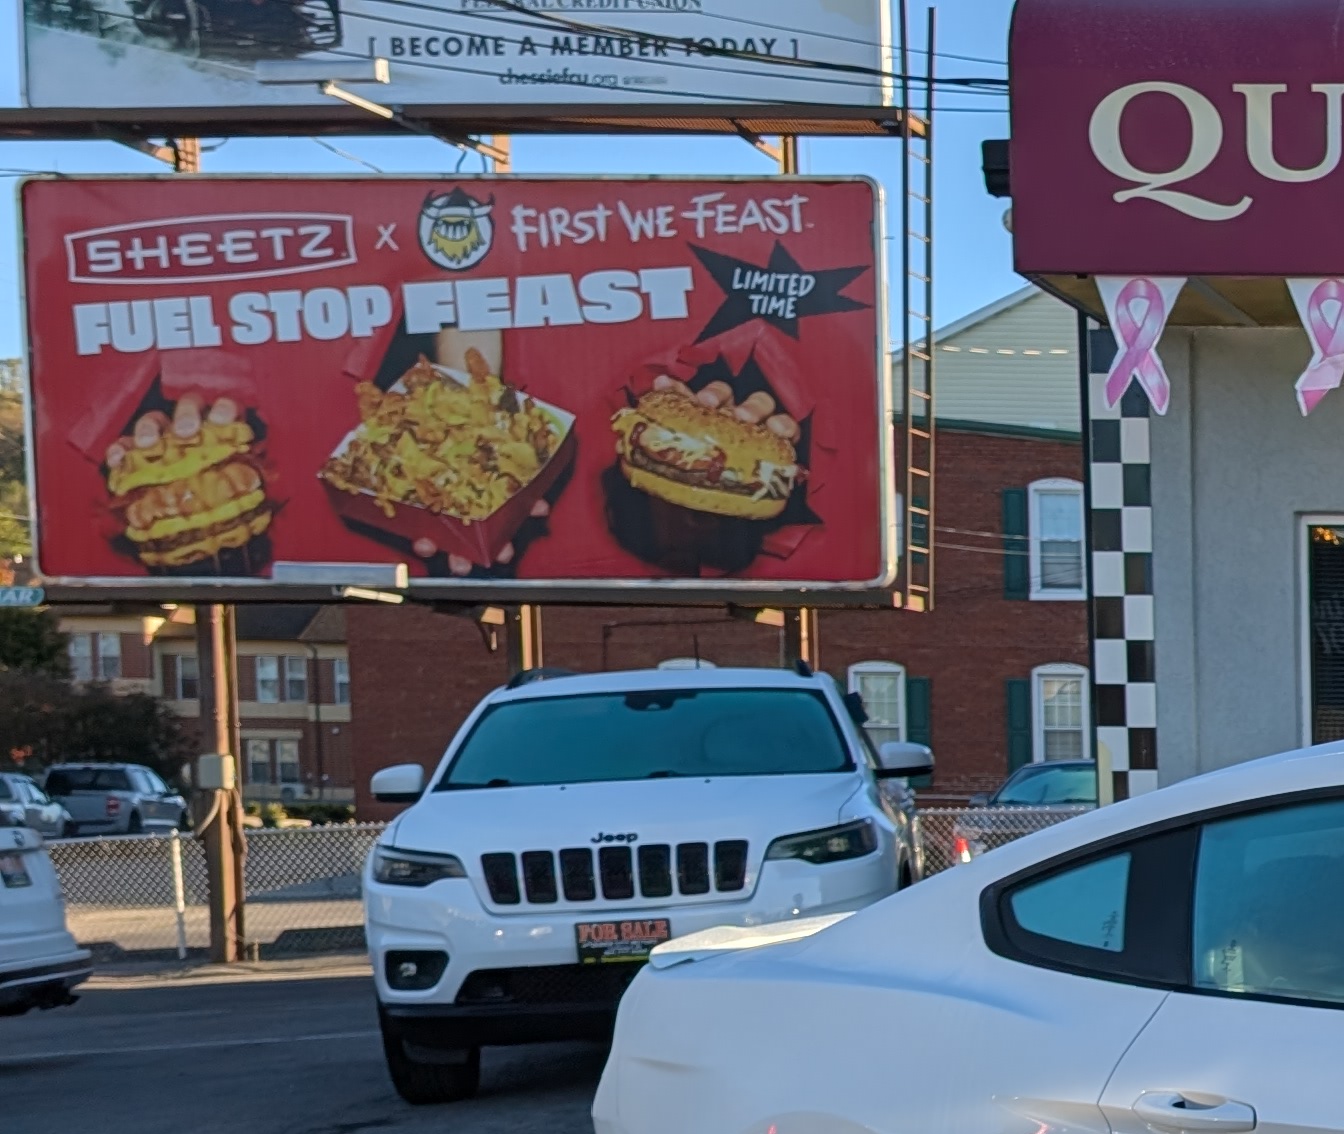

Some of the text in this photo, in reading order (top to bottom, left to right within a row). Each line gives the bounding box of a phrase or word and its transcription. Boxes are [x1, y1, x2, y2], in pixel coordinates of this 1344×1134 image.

[390, 36, 507, 58] BECOME
[518, 36, 538, 57] A
[550, 36, 669, 58] MEMBER
[681, 37, 777, 58] TODAY
[87, 224, 335, 273] SHEETZ
[511, 202, 613, 253] FIRST
[617, 199, 679, 243] WE
[680, 191, 810, 239] FEAST
[732, 267, 816, 297] LIMITED
[73, 266, 695, 356] FUEL STOP FEAST
[749, 294, 798, 320] TIME
[590, 831, 639, 844] Jeep
[577, 920, 669, 943] FOR SALE
